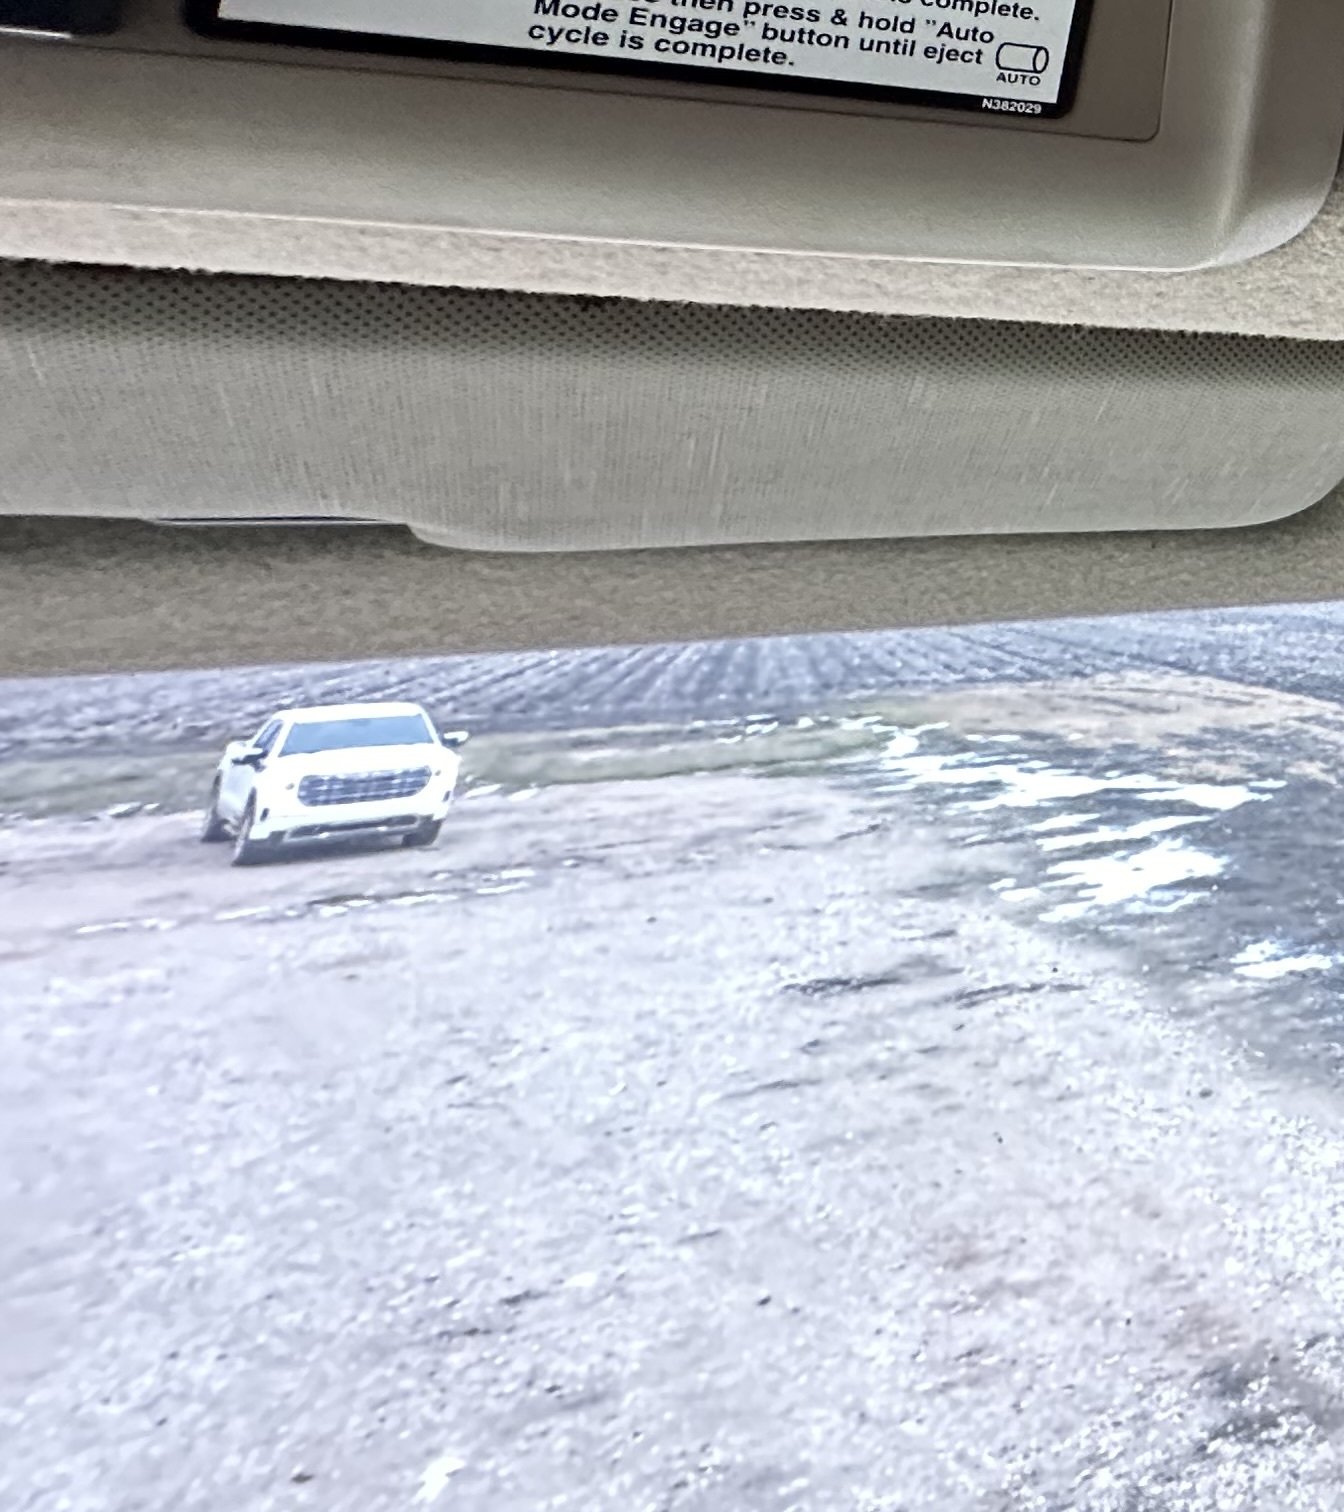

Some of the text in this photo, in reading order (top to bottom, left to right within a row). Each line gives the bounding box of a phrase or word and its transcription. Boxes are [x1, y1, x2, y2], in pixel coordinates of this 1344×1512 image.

[742, 1, 821, 23] press
[830, 8, 848, 27] &
[858, 10, 916, 34] hold
[528, 24, 795, 66] cycle is complete.
[761, 22, 850, 49] button
[859, 37, 916, 57] until
[923, 43, 984, 65] eject
[995, 72, 1041, 86] AUTO
[981, 98, 1042, 114] N382029
